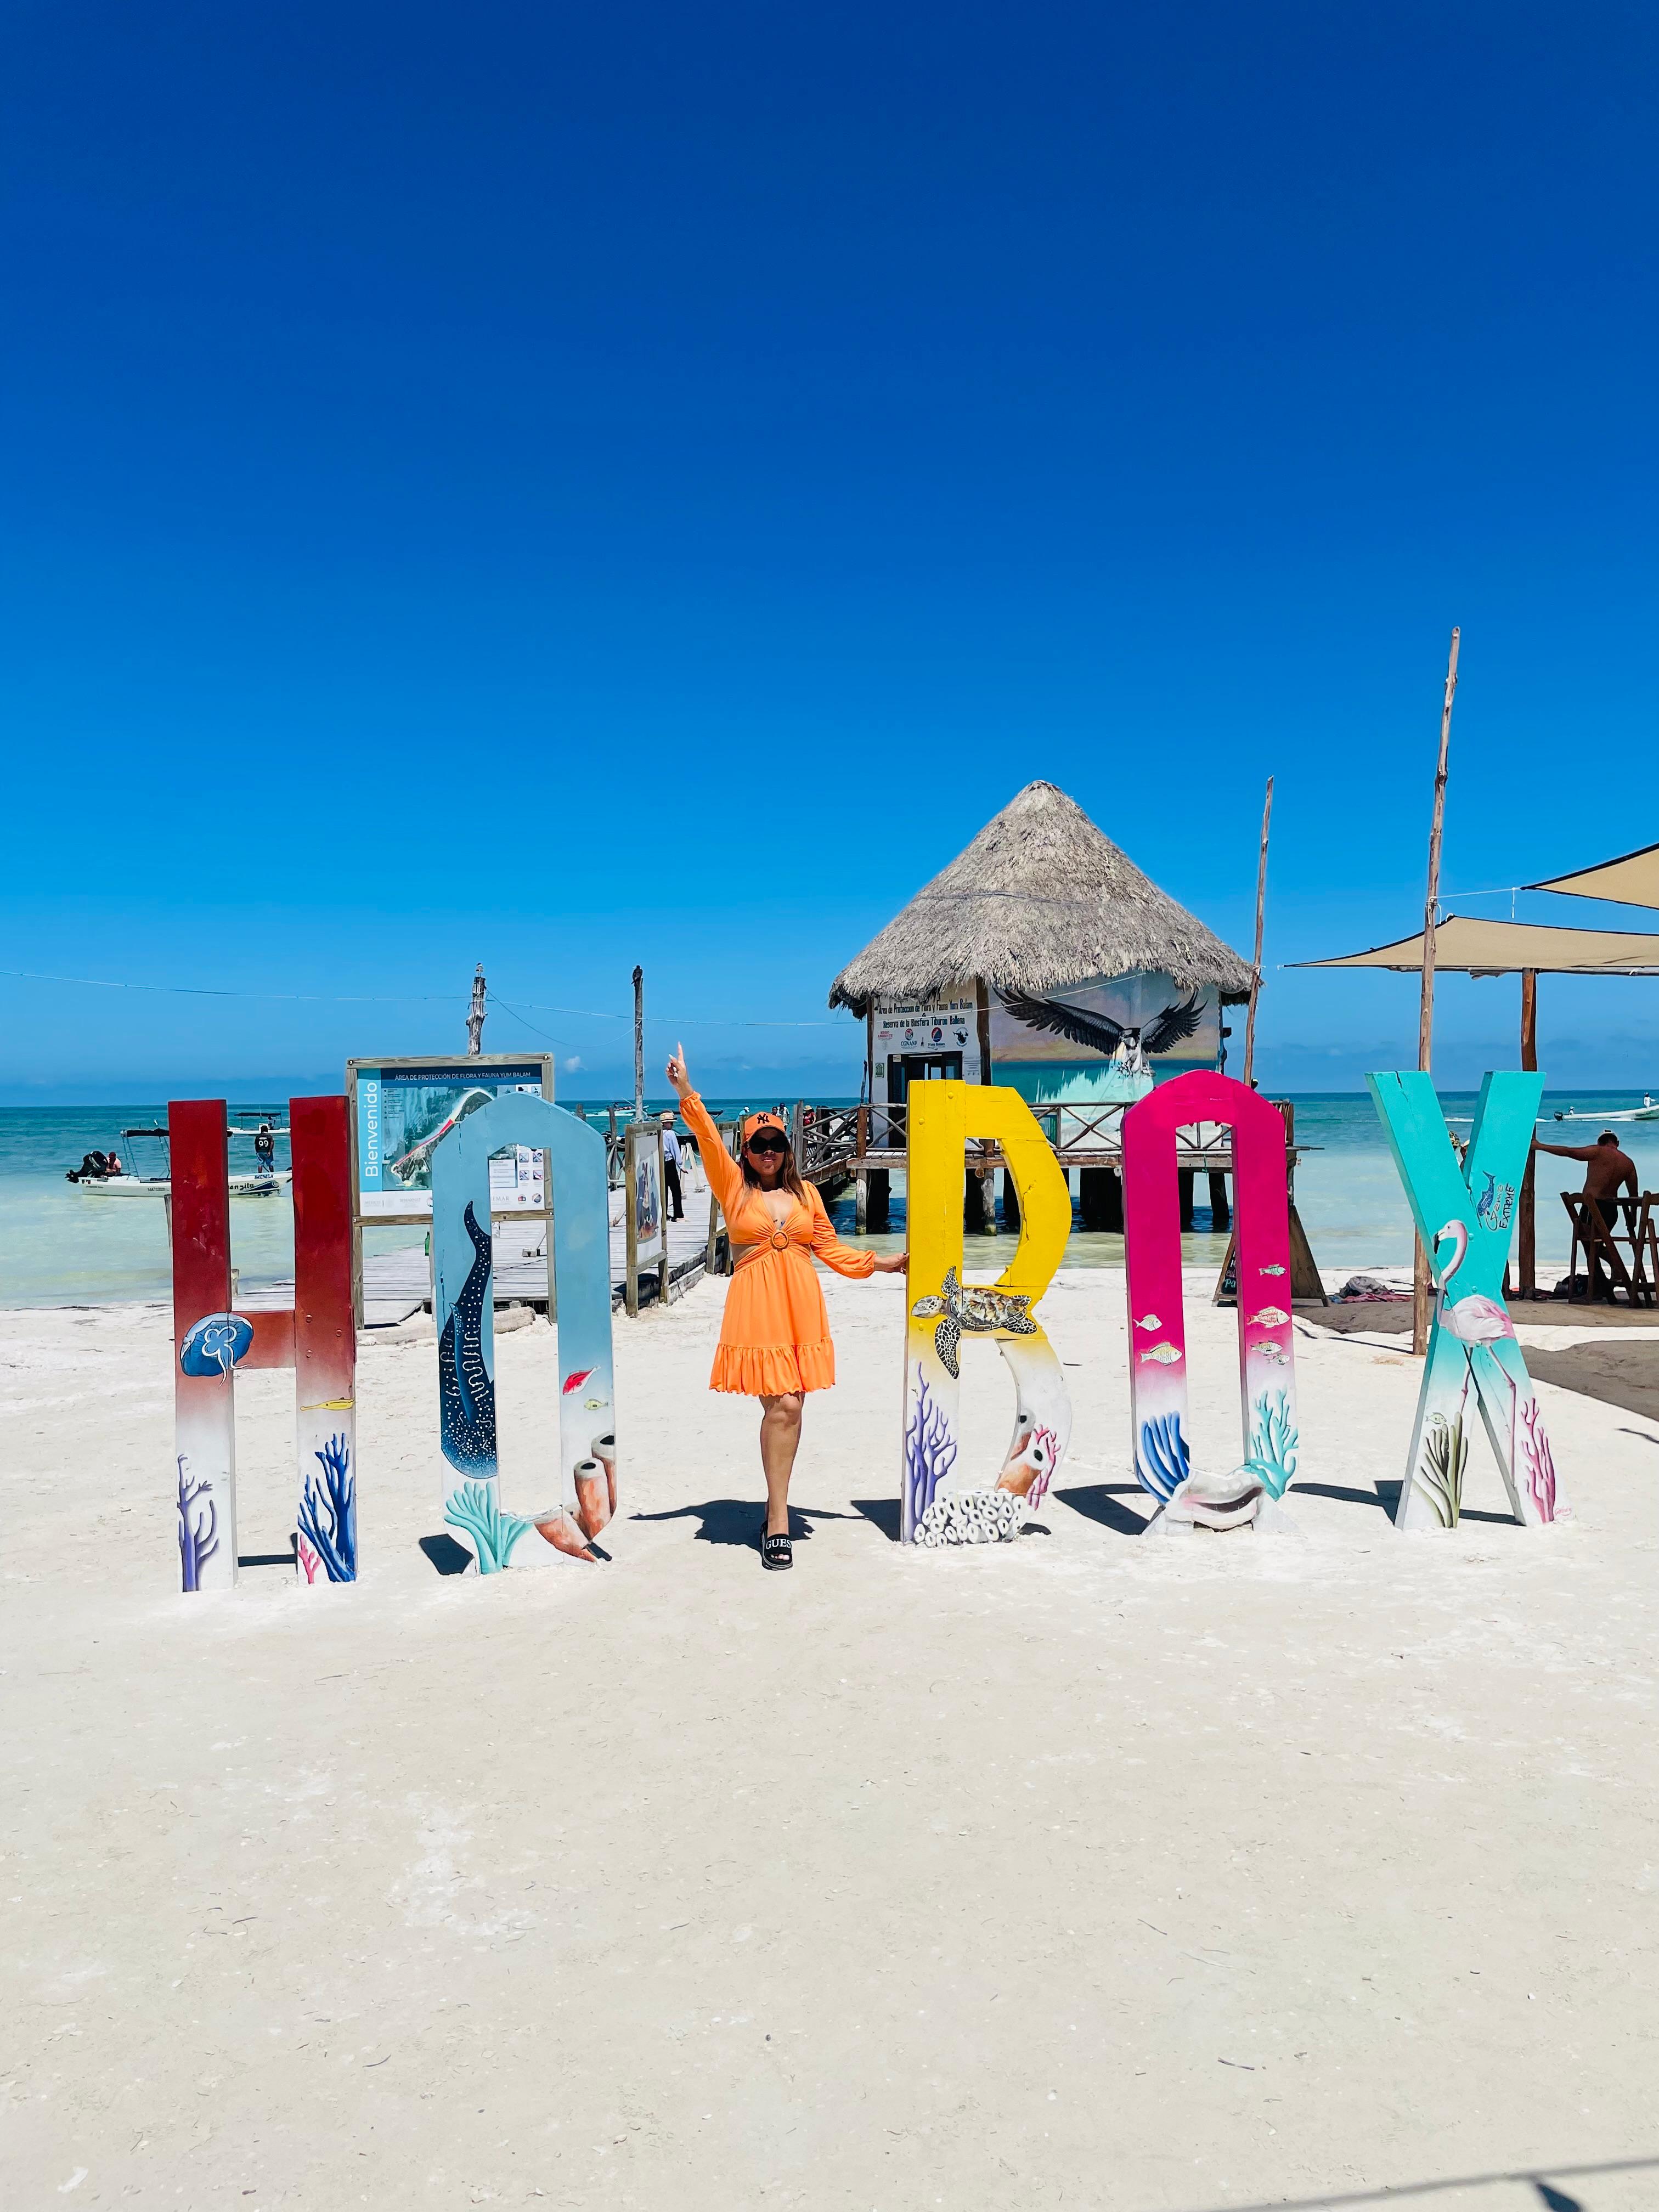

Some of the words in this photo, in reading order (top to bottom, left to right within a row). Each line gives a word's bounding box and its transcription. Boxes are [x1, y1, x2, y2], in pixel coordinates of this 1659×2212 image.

[936, 1000, 948, 1011] Fauna
[960, 998, 973, 1009] Balam
[883, 1020, 899, 1029] Reserva
[900, 1019, 905, 1028] de
[906, 1019, 910, 1028] la
[950, 1015, 965, 1025] Ballena
[364, 1082, 379, 1177] Bienvenido
[765, 1538, 792, 1549] GUES
